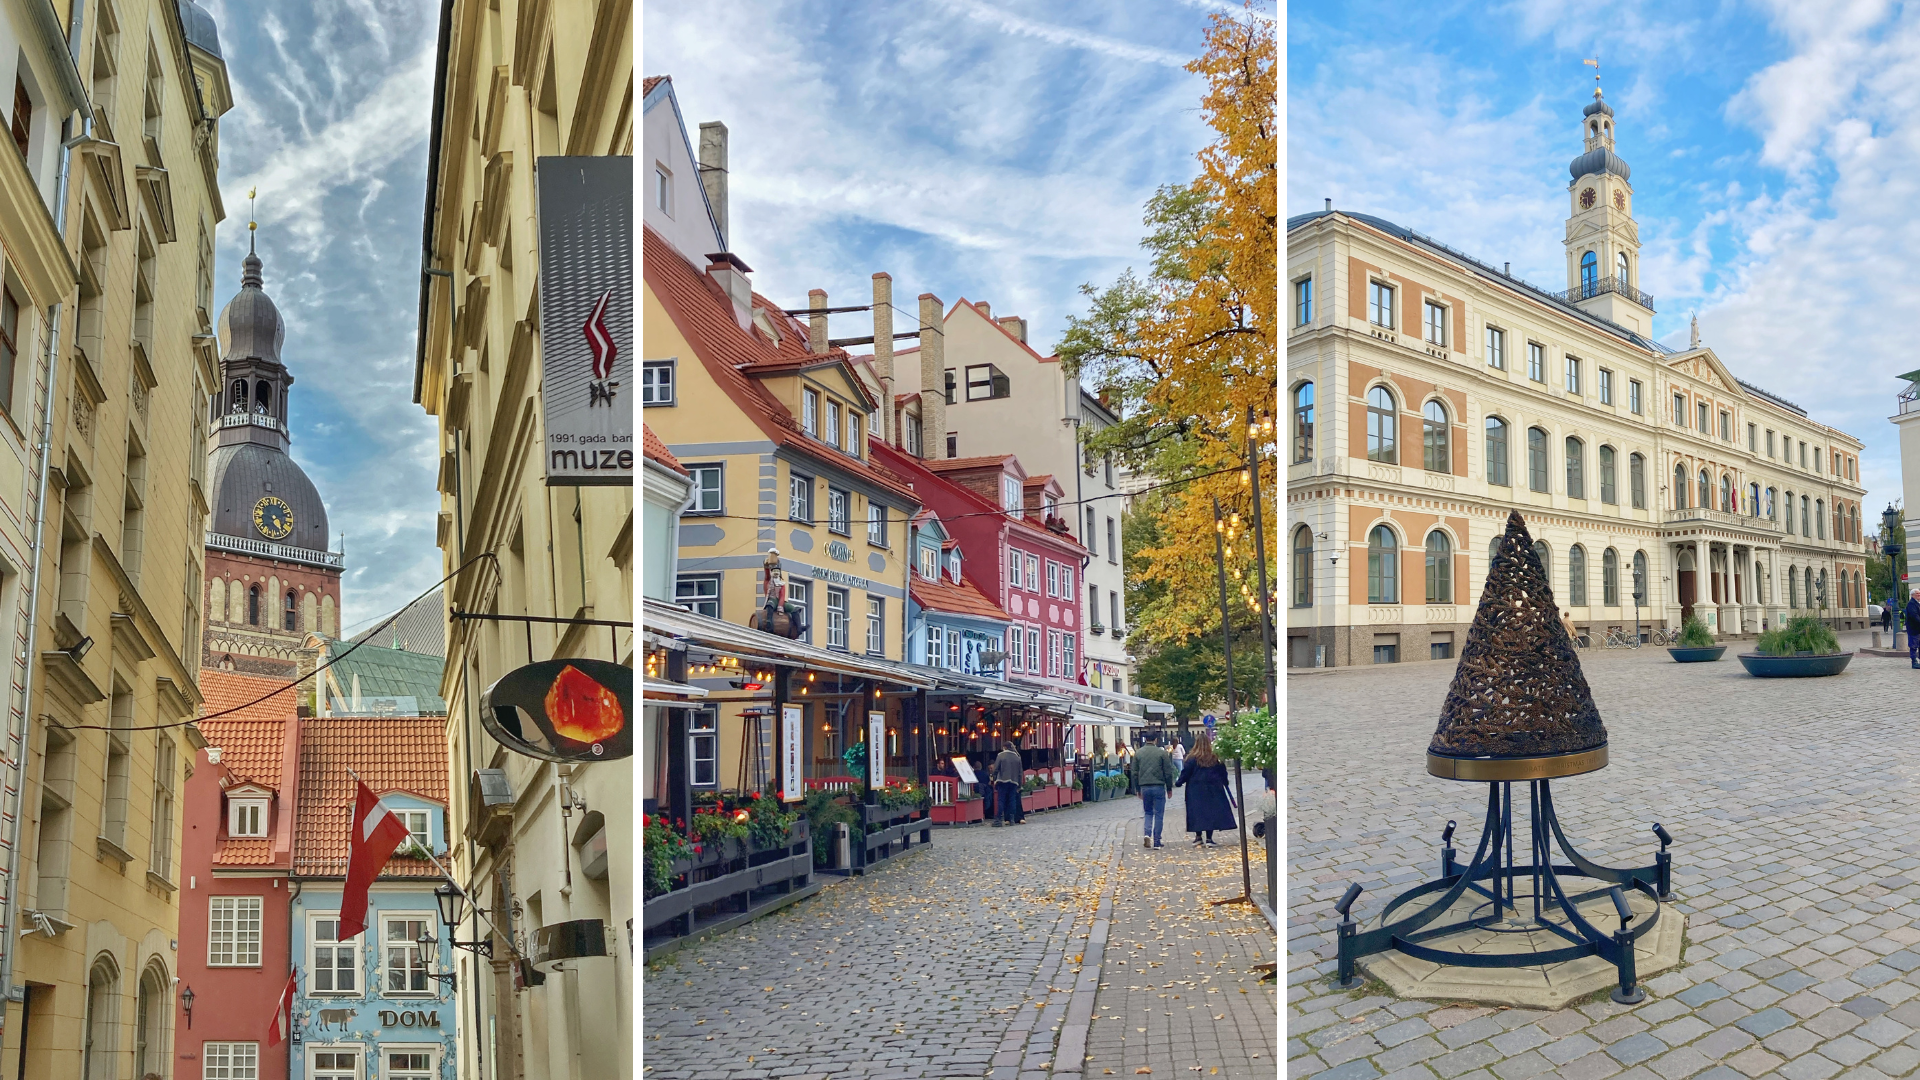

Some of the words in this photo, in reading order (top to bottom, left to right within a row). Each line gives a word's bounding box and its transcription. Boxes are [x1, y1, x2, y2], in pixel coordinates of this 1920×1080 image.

[549, 433, 577, 443] 1991.
[579, 433, 607, 446] gada
[612, 433, 633, 443] bari
[551, 449, 633, 470] muze
[378, 1010, 441, 1028] DOM
